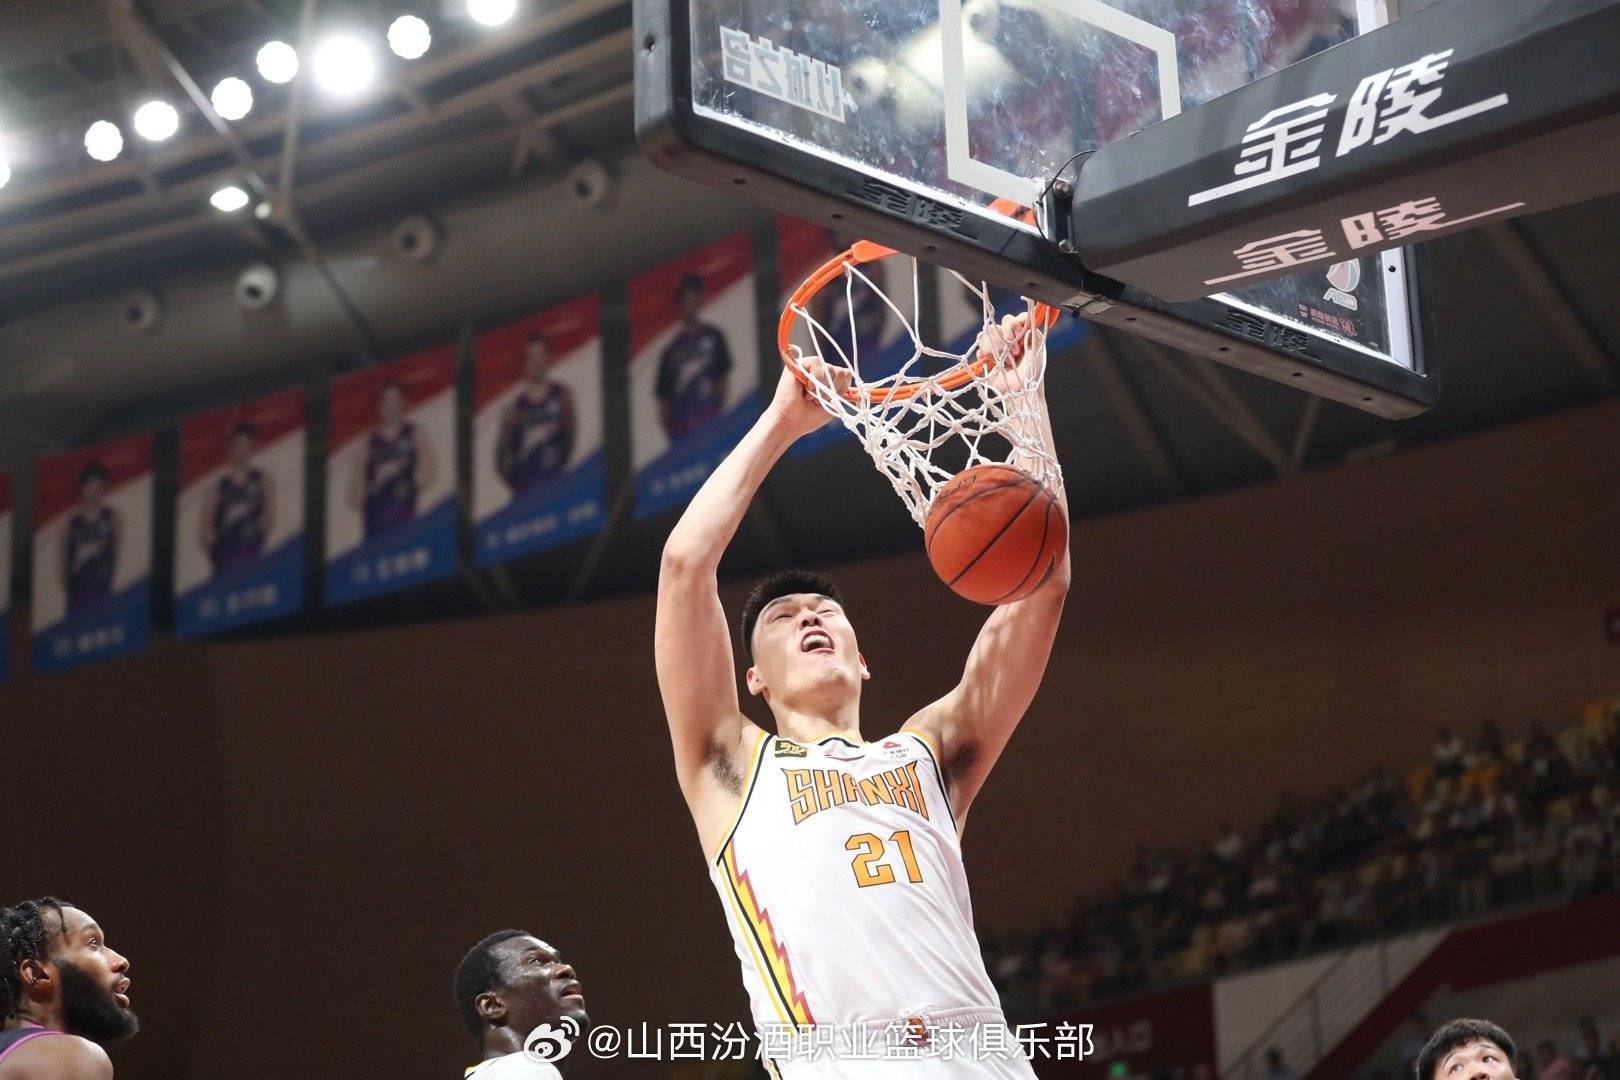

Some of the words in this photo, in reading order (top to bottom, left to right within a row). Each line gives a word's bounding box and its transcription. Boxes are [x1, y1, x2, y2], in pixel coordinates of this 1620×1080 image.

[1188, 48, 1508, 207] 金陵
[1204, 197, 1525, 285] 金陵
[780, 760, 930, 826] SHANXI
[844, 830, 924, 888] 21
